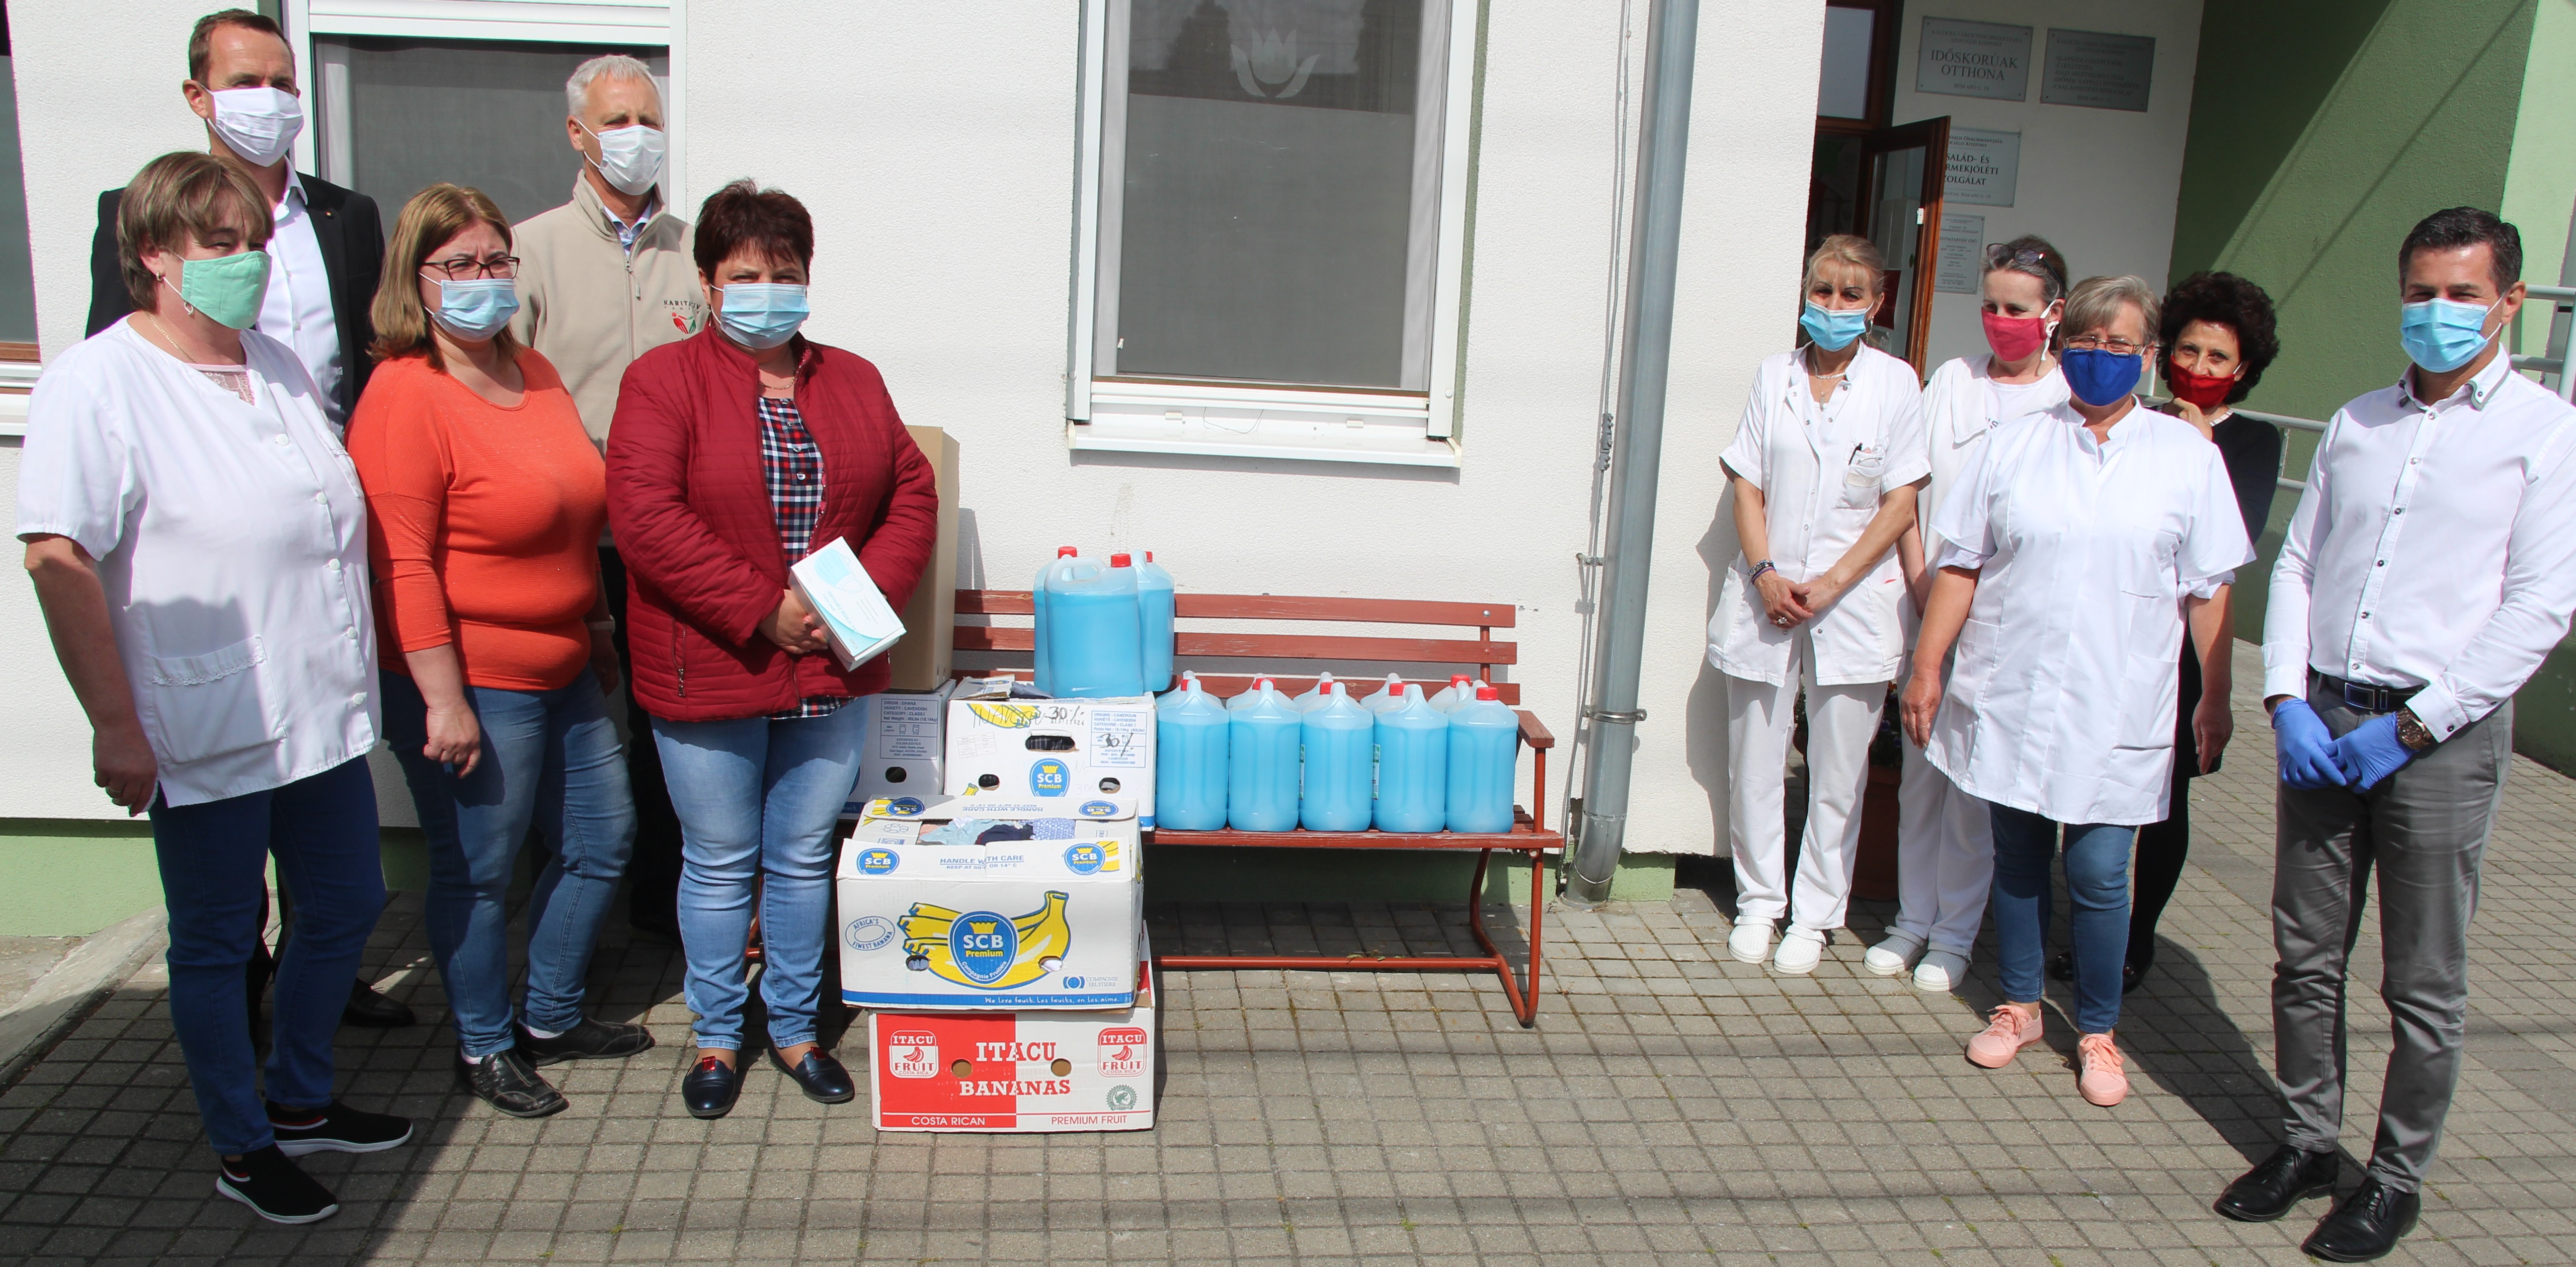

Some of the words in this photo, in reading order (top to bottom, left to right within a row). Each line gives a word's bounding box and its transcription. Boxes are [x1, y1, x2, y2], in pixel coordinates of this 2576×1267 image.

[1931, 48, 2017, 68] IDŐSKORÚAK
[1941, 65, 2005, 81] OTTHONA
[1946, 153, 1977, 163] SALÁD-
[1980, 154, 1990, 164] ÉS
[1945, 164, 1999, 175] RMEKJÓLÉTI
[1944, 175, 1986, 185] ZOLGÁLAT
[1037, 773, 1062, 783] SCB
[853, 918, 879, 930] AFRICA'S
[873, 931, 893, 948] BANANA
[963, 934, 1004, 949] SCB
[962, 961, 989, 979] Compagnie
[893, 1035, 934, 1044] ITACU
[1102, 1034, 1142, 1043] ITACU
[975, 1042, 1056, 1062] ITACU
[894, 1062, 934, 1071] FRUIT
[1103, 1061, 1142, 1070] FRUIT
[959, 1079, 1071, 1097] BANANAS
[911, 1116, 948, 1126] COSTA
[951, 1116, 986, 1126] RICAN
[1051, 1116, 1098, 1125] PREMIUM
[1101, 1115, 1127, 1124] FRUIT
